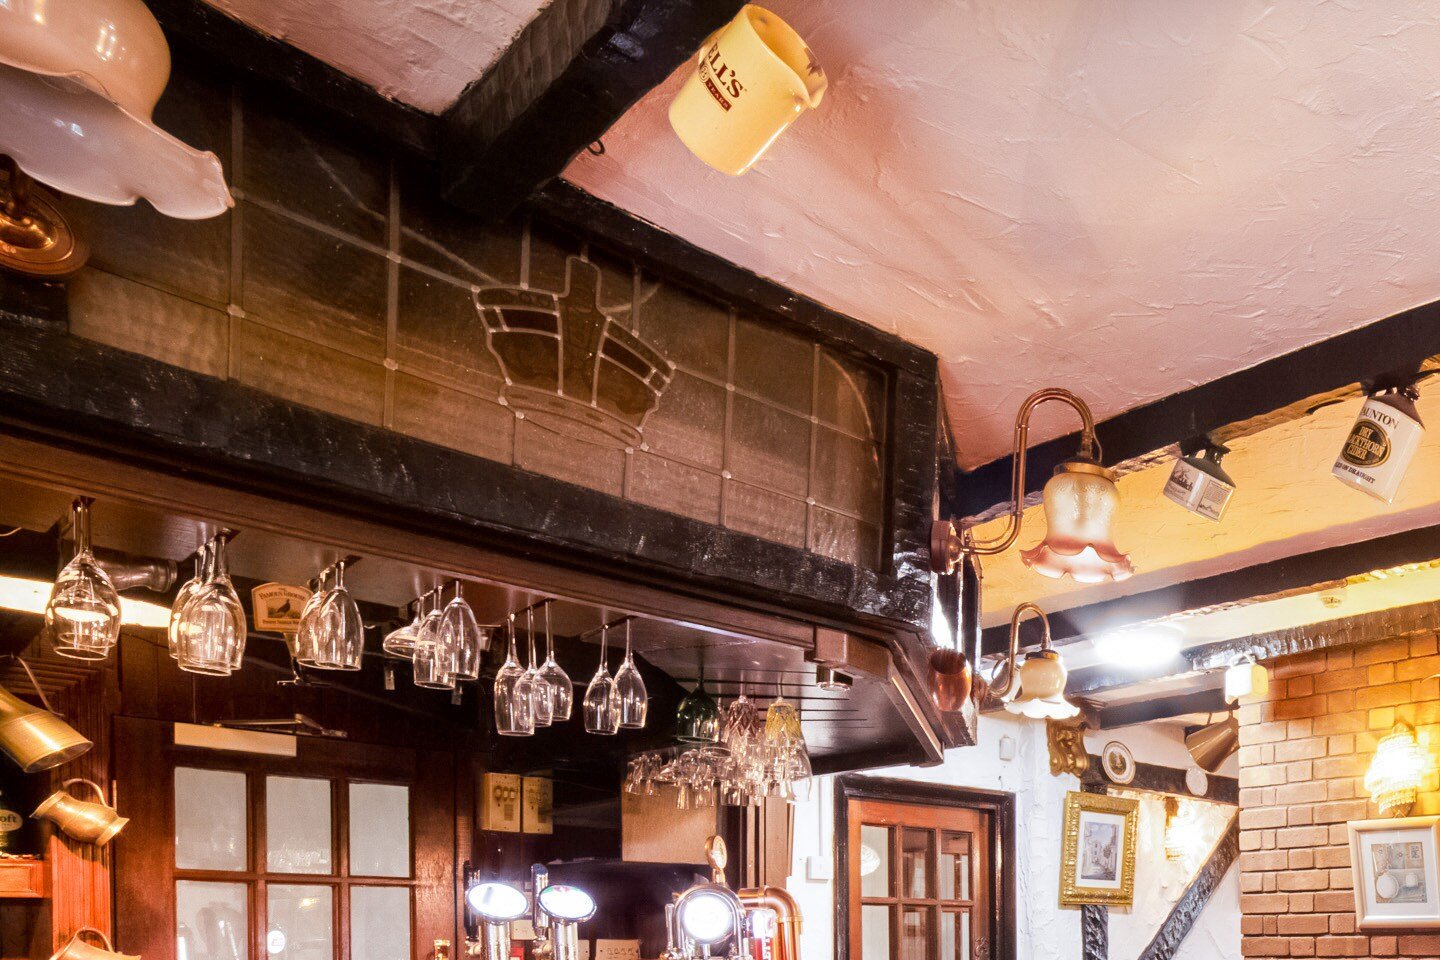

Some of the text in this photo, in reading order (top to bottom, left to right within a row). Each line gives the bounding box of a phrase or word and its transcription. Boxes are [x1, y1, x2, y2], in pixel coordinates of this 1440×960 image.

[708, 42, 744, 98] ELL'S
[1361, 406, 1399, 429] AUNTON
[1359, 426, 1374, 439] DRY
[1346, 444, 1368, 460] CIDER
[1348, 434, 1386, 457] ACKTHORN
[0, 814, 17, 823] oft
